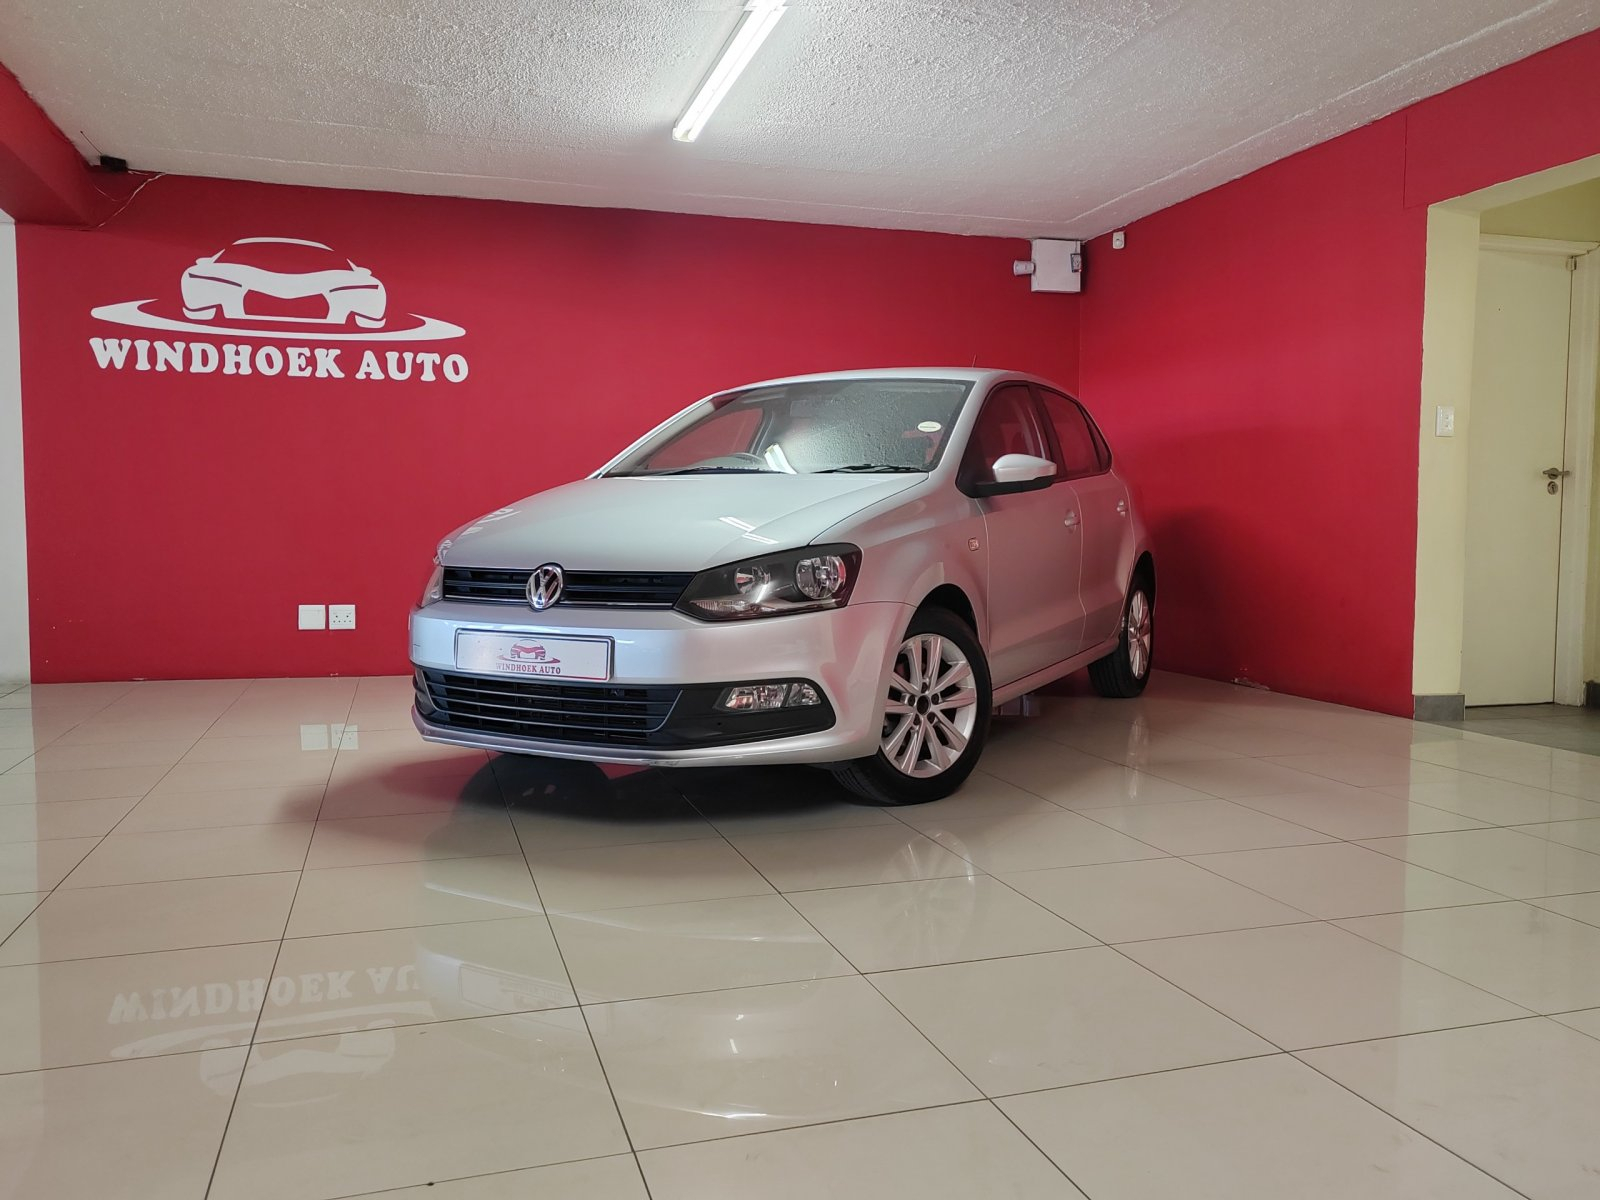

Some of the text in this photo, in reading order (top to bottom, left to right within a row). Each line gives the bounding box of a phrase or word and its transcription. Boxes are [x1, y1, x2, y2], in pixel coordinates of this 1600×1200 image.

[89, 337, 469, 383] WINDHOEK AUTO
[496, 662, 561, 674] WINDHOEK AUTO
